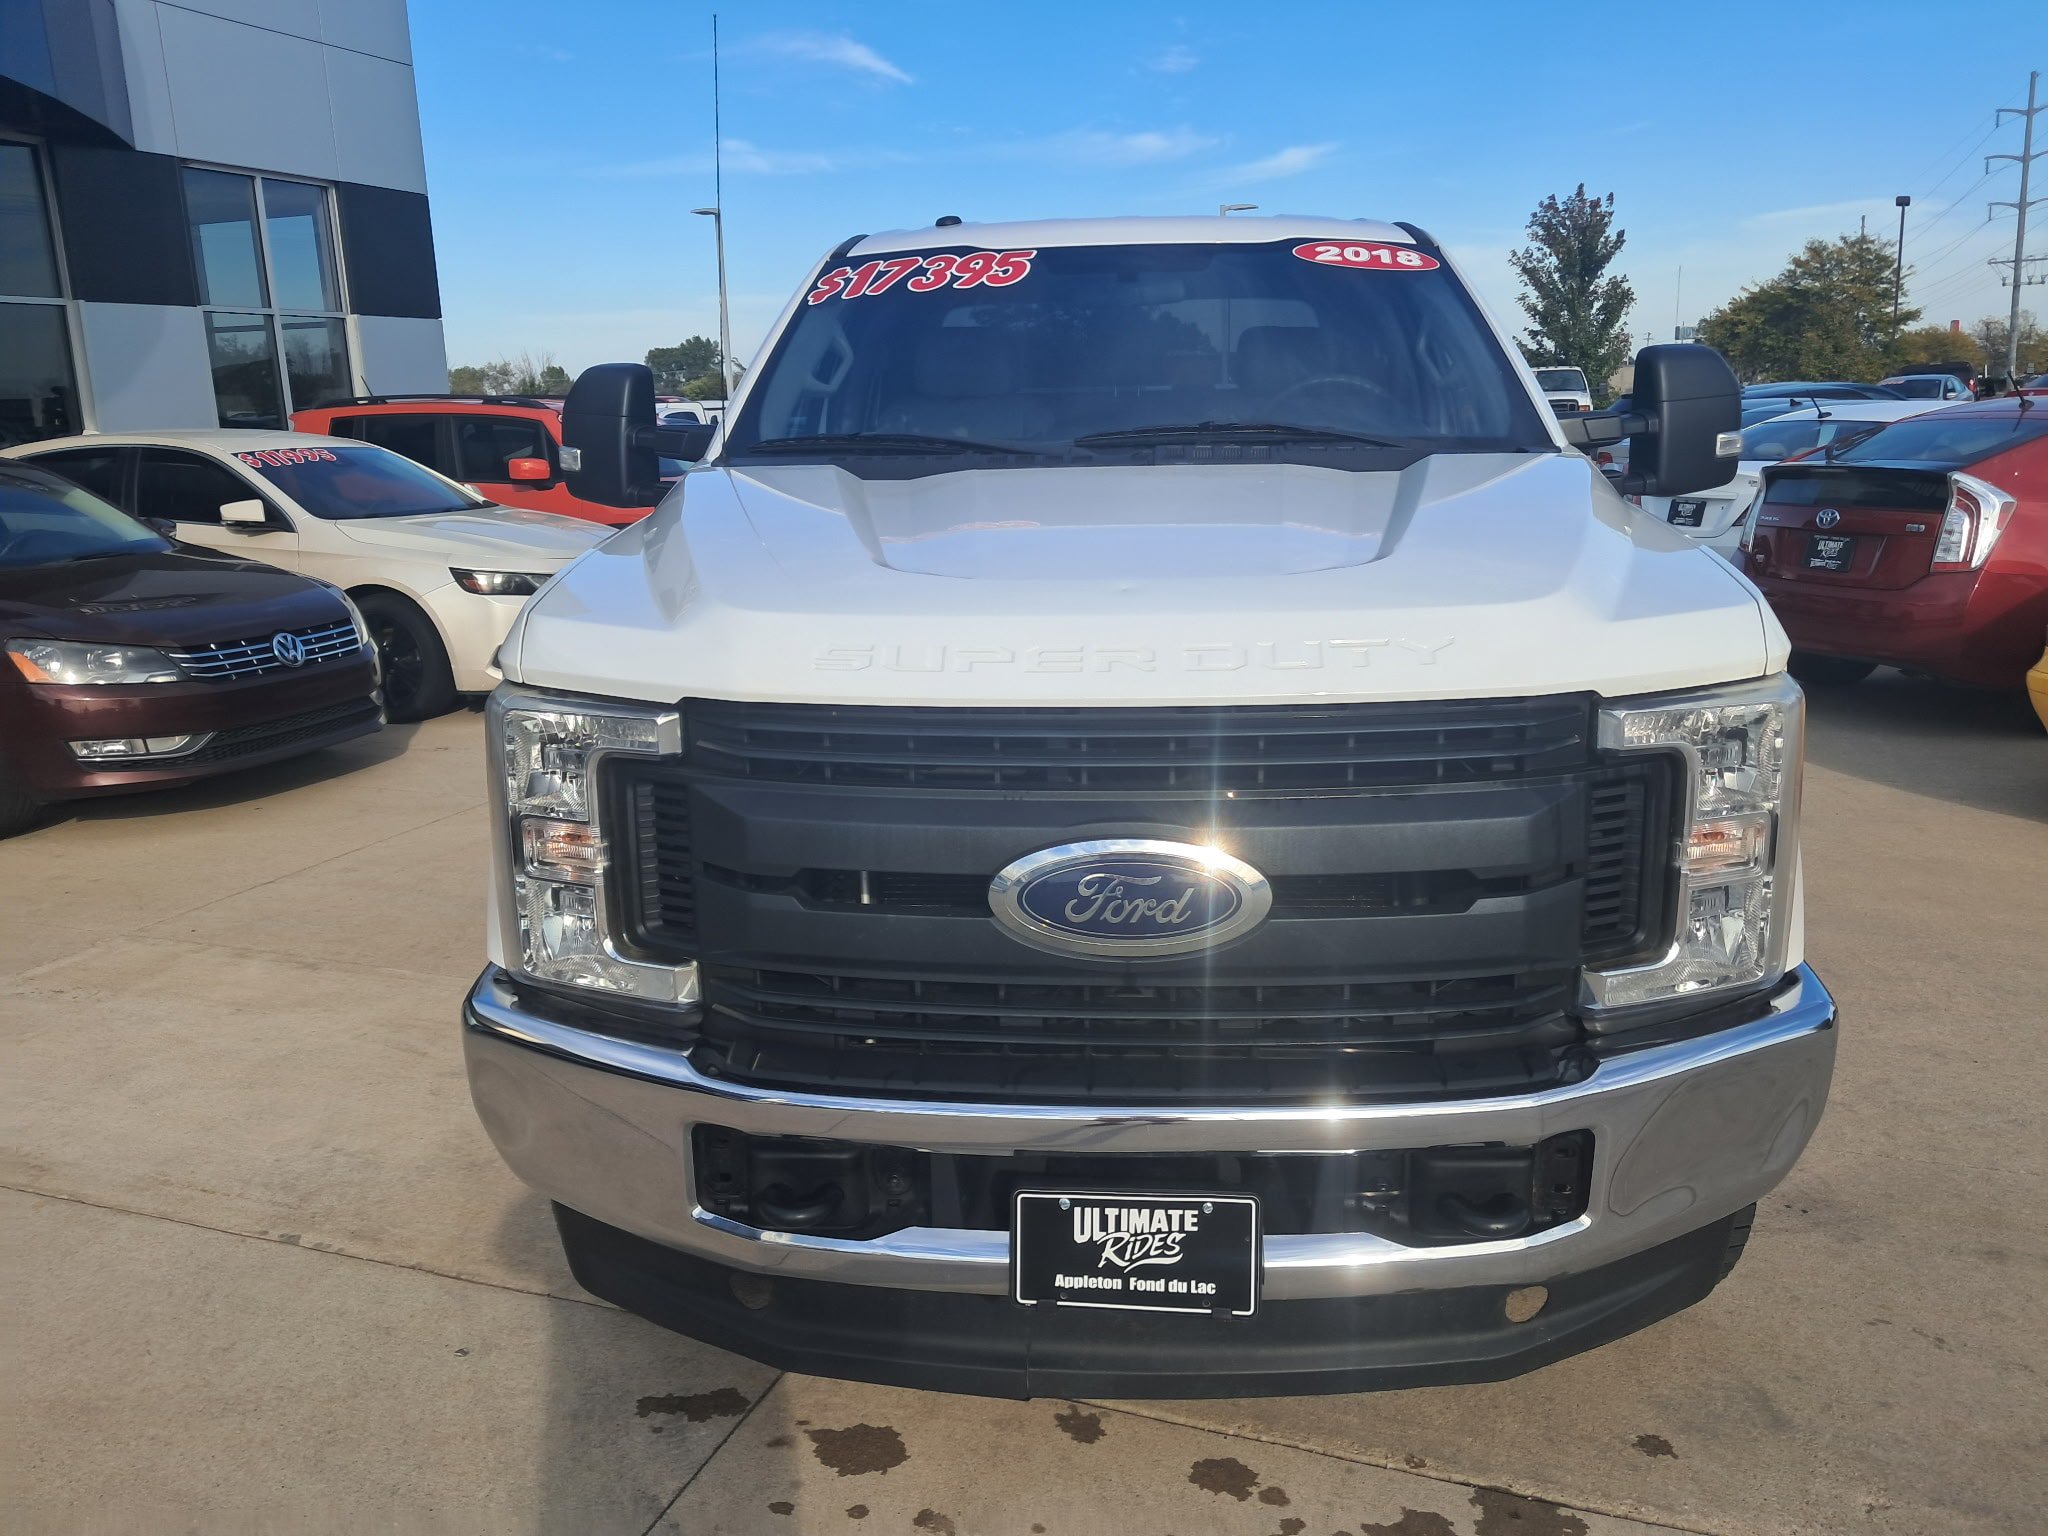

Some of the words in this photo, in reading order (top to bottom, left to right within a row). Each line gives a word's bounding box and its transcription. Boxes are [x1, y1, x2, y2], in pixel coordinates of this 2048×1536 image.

[1314, 245, 1424, 268] 2018
[808, 250, 1038, 306] $17395
[238, 448, 337, 469] $11995
[810, 639, 1157, 673] SUPER
[1181, 634, 1456, 673] DUTY
[1064, 872, 1195, 924] Ford
[1073, 1206, 1199, 1244] ULTIMATE
[1054, 1273, 1123, 1291] Appleton
[1129, 1277, 1165, 1293] Fond
[1168, 1279, 1188, 1294] du
[1190, 1279, 1217, 1295] Lac
